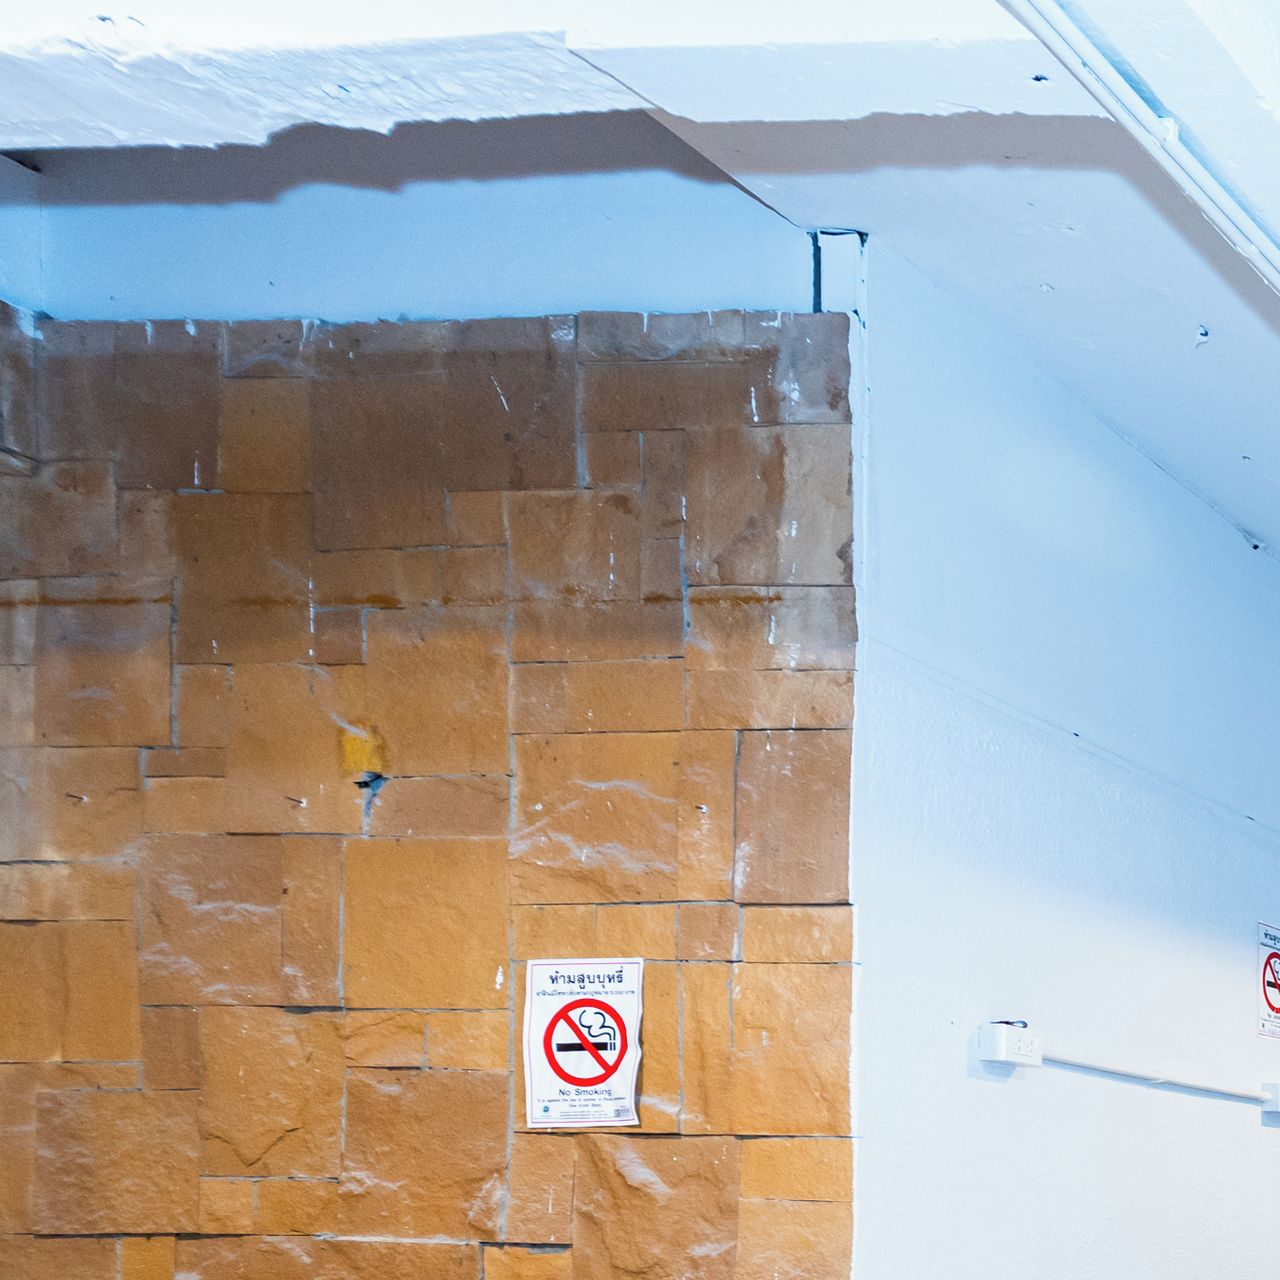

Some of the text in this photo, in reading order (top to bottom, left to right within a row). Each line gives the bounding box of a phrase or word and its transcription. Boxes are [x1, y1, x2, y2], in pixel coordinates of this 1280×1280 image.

[549, 966, 624, 989] ห้ามสูบบุหรี่
[558, 1088, 612, 1097] No Smoking
